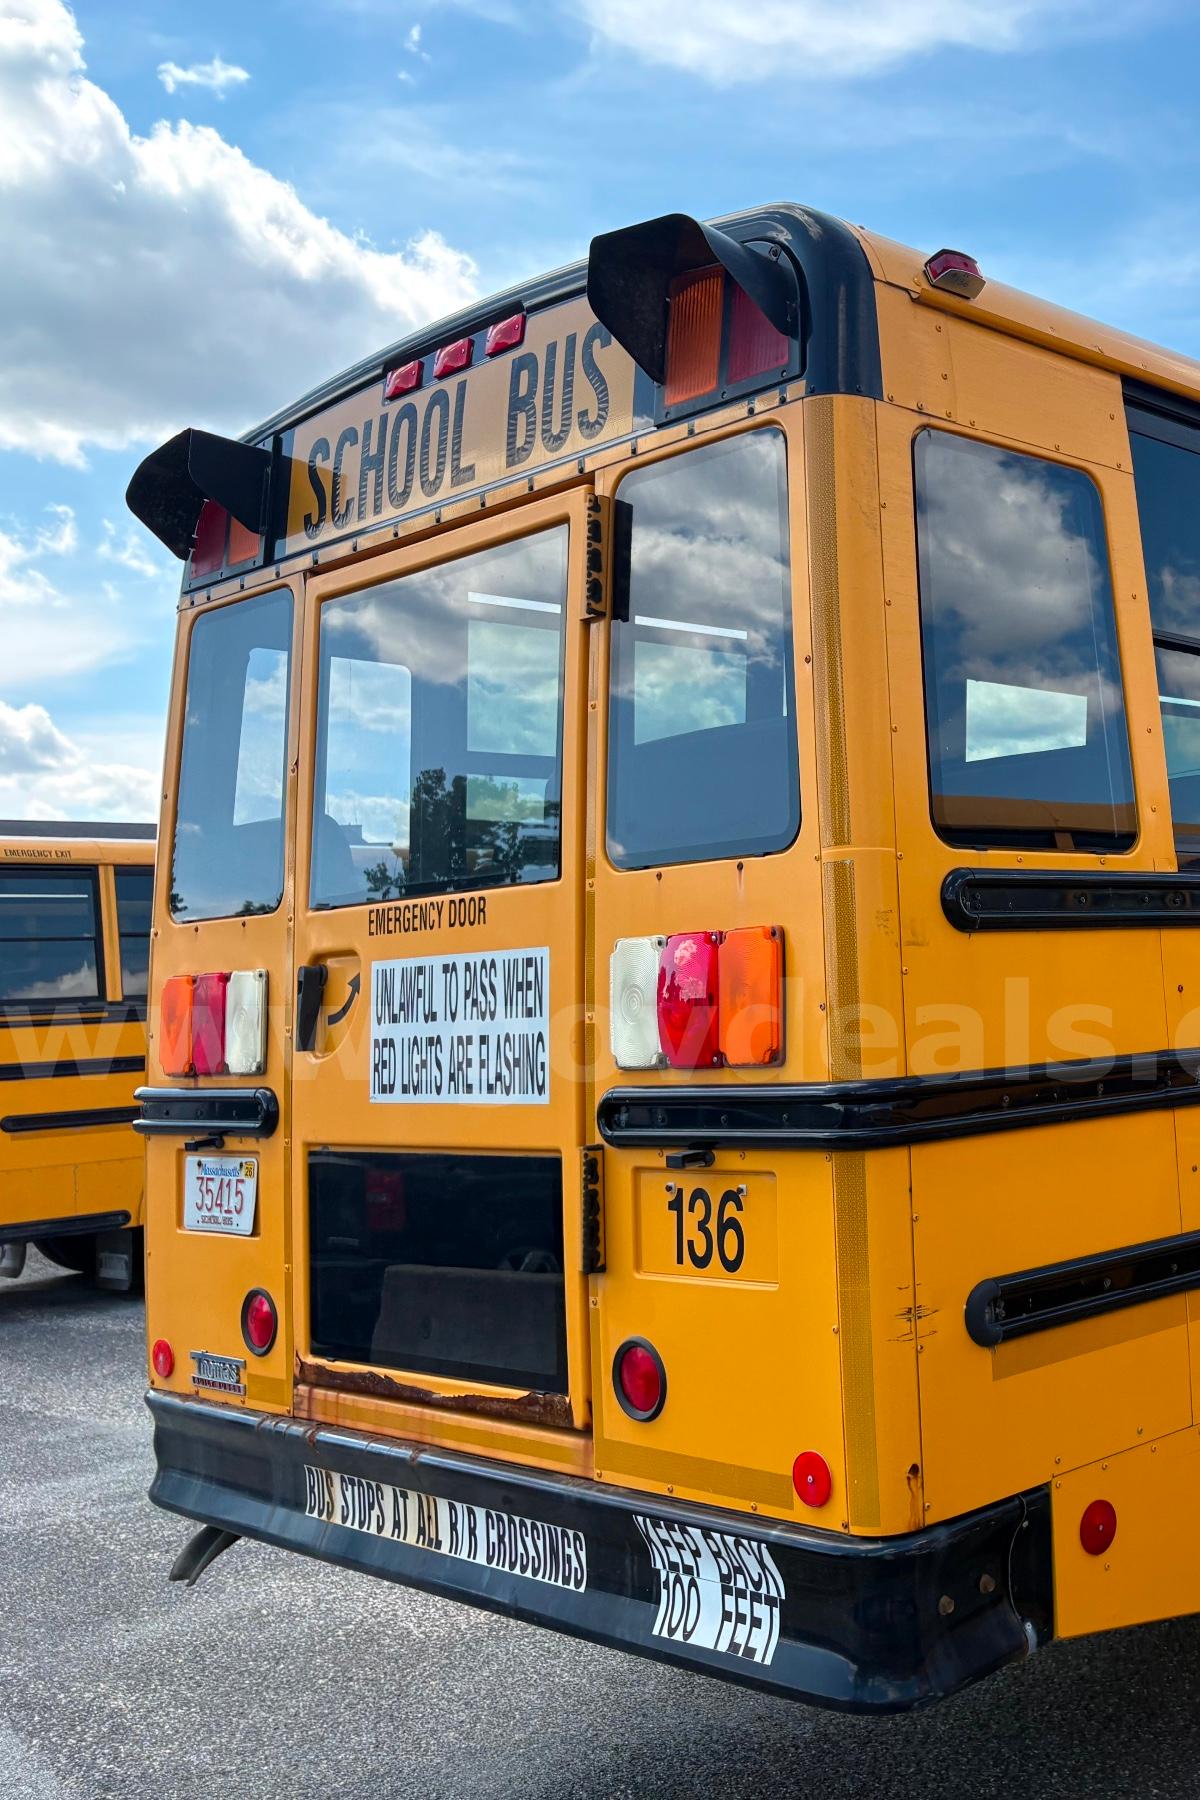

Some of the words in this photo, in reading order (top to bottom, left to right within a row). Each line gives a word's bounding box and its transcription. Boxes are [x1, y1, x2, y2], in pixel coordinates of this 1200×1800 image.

[304, 379, 476, 540] SCHOOL
[505, 321, 612, 469] BUS
[4, 849, 52, 858] EMERGENCY
[55, 850, 72, 859] EXIT
[368, 900, 445, 936] EMERGENCY
[449, 896, 487, 929] DOOR
[376, 965, 437, 1026] UNLAWFUL
[442, 961, 459, 1023] TO
[464, 958, 497, 1022] PASS
[502, 956, 544, 1019] WHEN
[373, 1037, 397, 1095] RED
[401, 1034, 443, 1096] LIGHTS
[447, 1034, 474, 1095] ARE
[479, 1031, 546, 1097] FLASHING
[195, 1176, 245, 1215] 35415
[668, 1187, 745, 1273] 136
[306, 1467, 335, 1521] BUS
[340, 1474, 385, 1535] STOPS
[390, 1488, 410, 1541] AT
[415, 1491, 442, 1550] ALL
[448, 1501, 478, 1560] R/R
[484, 1509, 586, 1591] CROSSINGS
[634, 1515, 702, 1578] KEEP
[700, 1529, 782, 1597] BACK
[658, 1570, 702, 1642] 100
[714, 1583, 779, 1663] FEET
